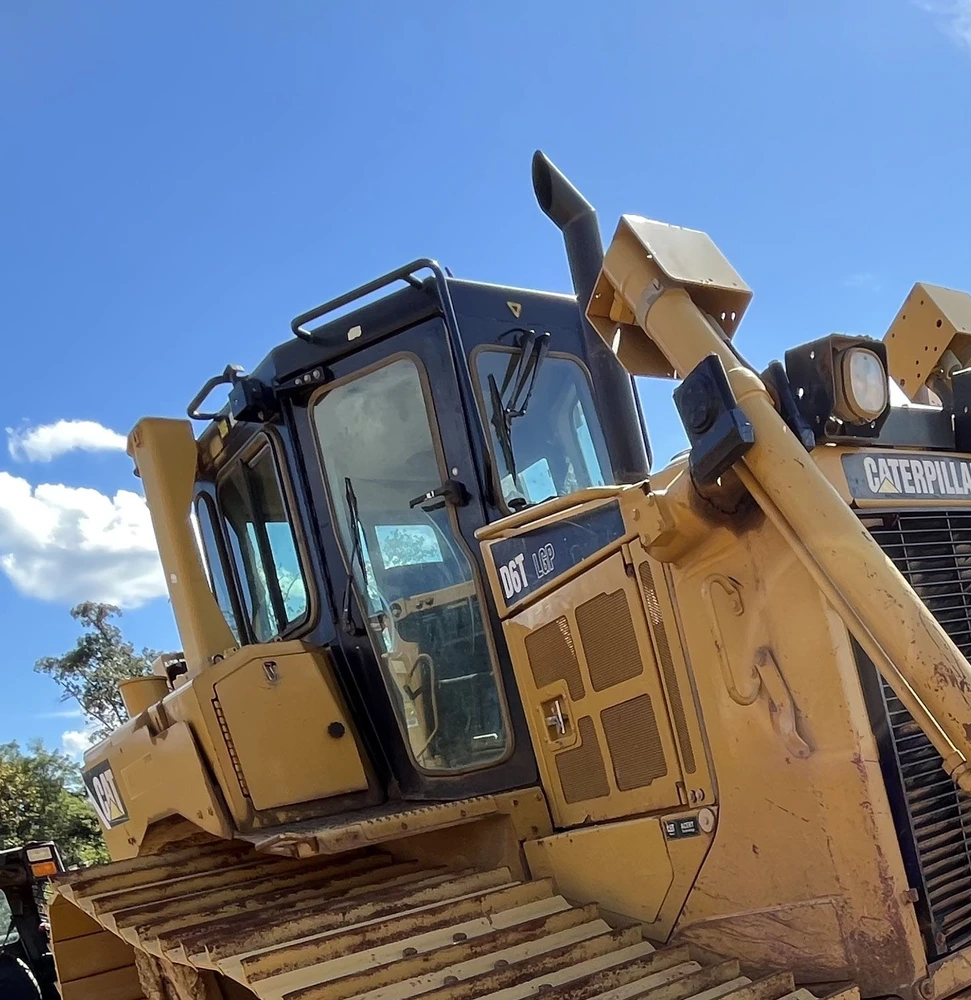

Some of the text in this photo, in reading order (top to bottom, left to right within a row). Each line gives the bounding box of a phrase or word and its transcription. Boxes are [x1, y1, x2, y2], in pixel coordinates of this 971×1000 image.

[499, 542, 555, 599] D6T LGP
[92, 768, 125, 822] CAT
